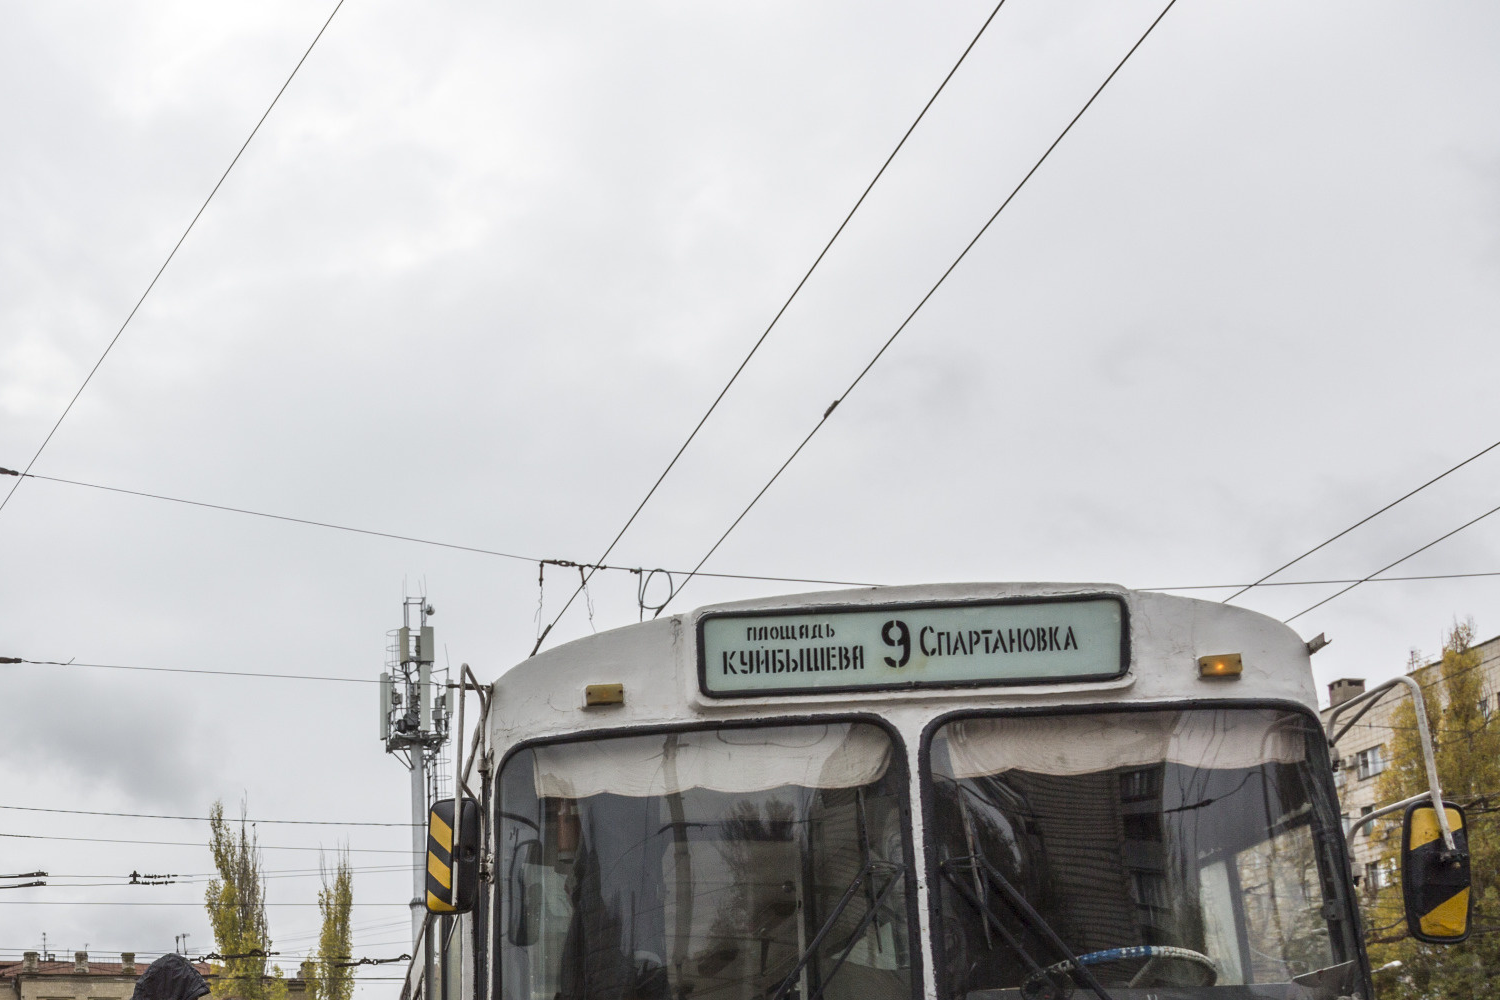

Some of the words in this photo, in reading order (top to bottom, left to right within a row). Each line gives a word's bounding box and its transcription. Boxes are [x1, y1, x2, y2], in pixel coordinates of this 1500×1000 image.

[746, 623, 835, 642] ПЛОЩАДЬ
[880, 619, 912, 669] 9
[721, 644, 865, 675] КУЙБЫШЕВА
